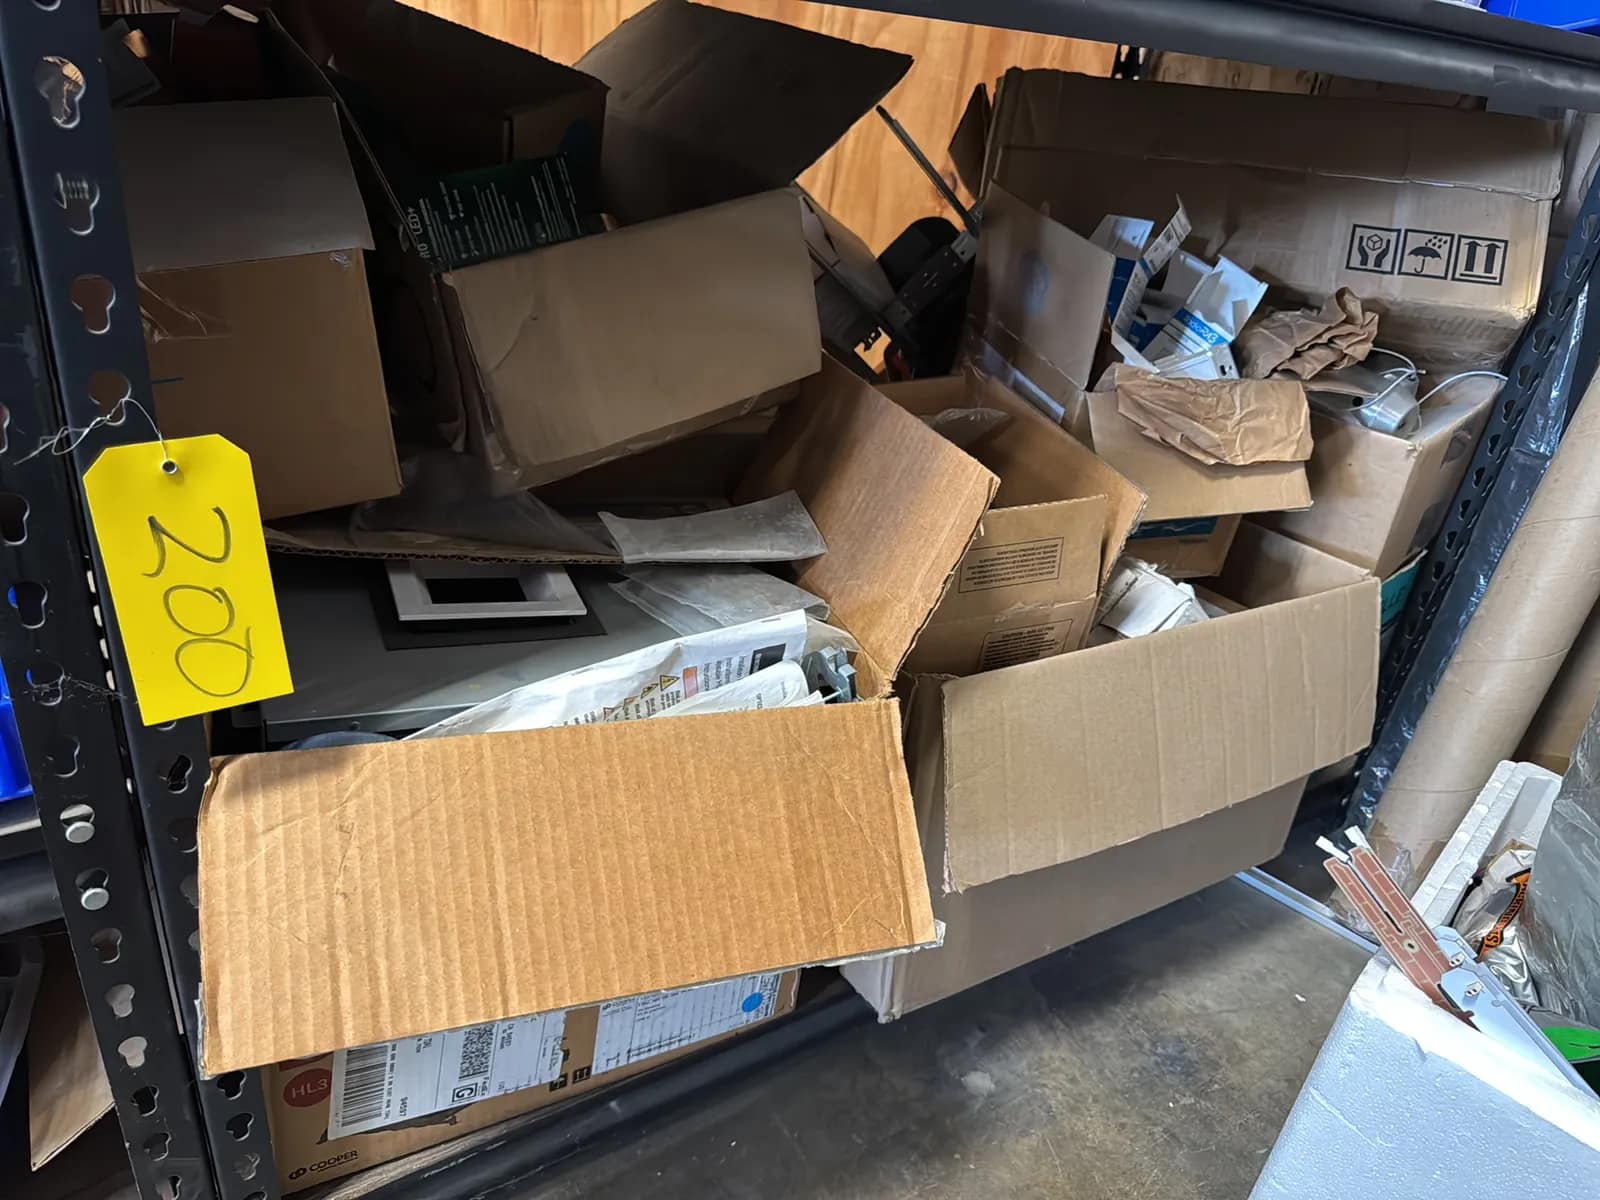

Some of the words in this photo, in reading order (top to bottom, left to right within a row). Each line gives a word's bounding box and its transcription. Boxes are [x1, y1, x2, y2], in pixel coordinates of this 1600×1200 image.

[141, 506, 254, 697] 200
[291, 1078, 328, 1099] HL3
[455, 1087, 474, 1099] G
[309, 1150, 359, 1172] COOPER
